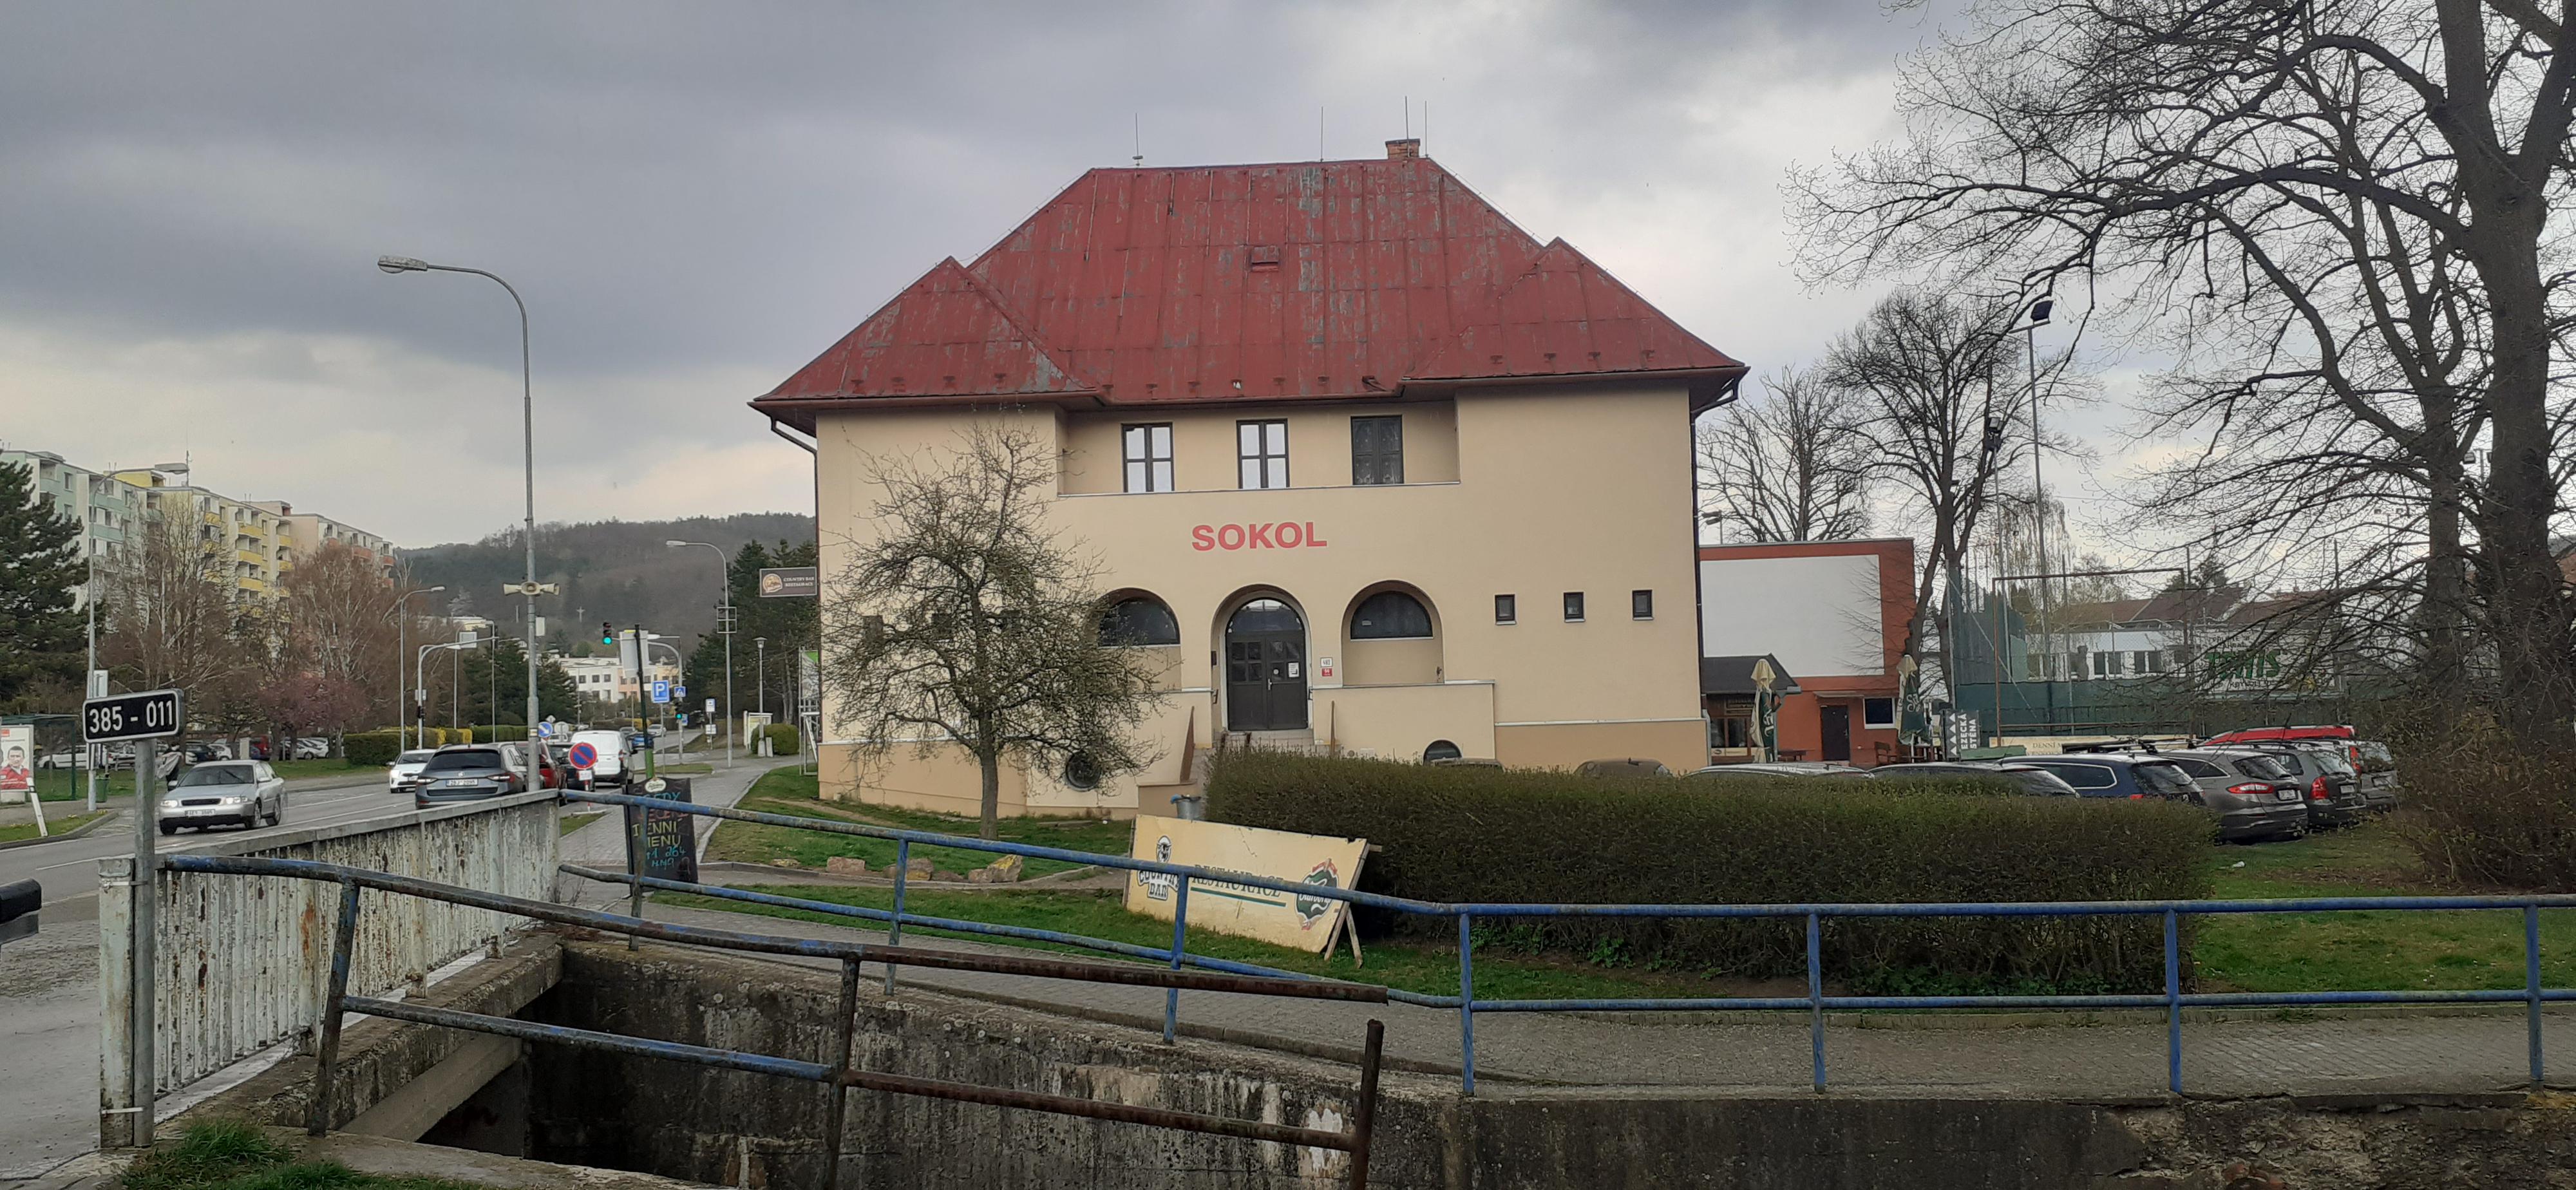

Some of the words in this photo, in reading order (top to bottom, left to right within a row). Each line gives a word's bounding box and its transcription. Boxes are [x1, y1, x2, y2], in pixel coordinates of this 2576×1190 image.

[1191, 522, 1327, 551] SOKOL
[655, 683, 665, 696] P
[89, 706, 123, 733] 385
[146, 700, 173, 728] 011
[1958, 713, 1969, 750] EZECKÁ
[1967, 719, 1978, 749] STĚNA
[1149, 882, 1168, 898] BAR
